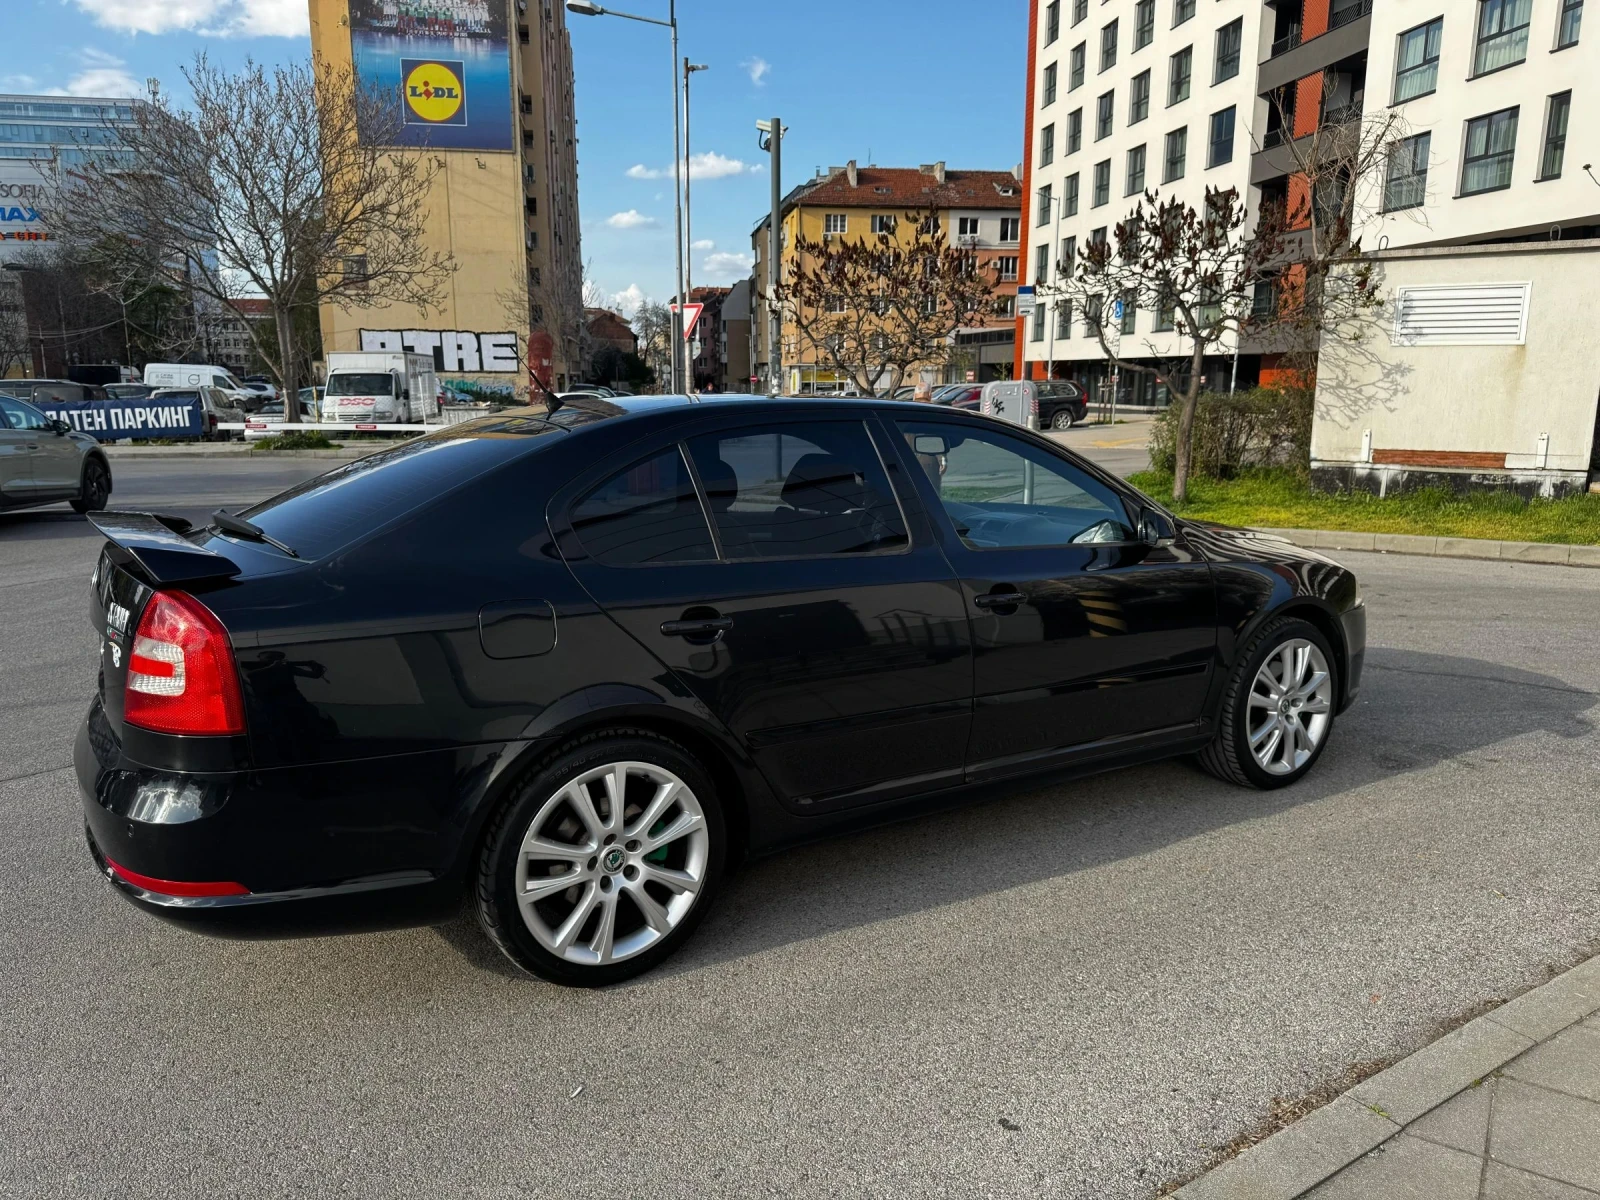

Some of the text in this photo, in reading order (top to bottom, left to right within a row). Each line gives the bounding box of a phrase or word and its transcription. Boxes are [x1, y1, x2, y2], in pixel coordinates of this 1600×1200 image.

[0, 183, 48, 198] SOFIA
[32, 405, 193, 431] АТЕН ПАРКИНГ
